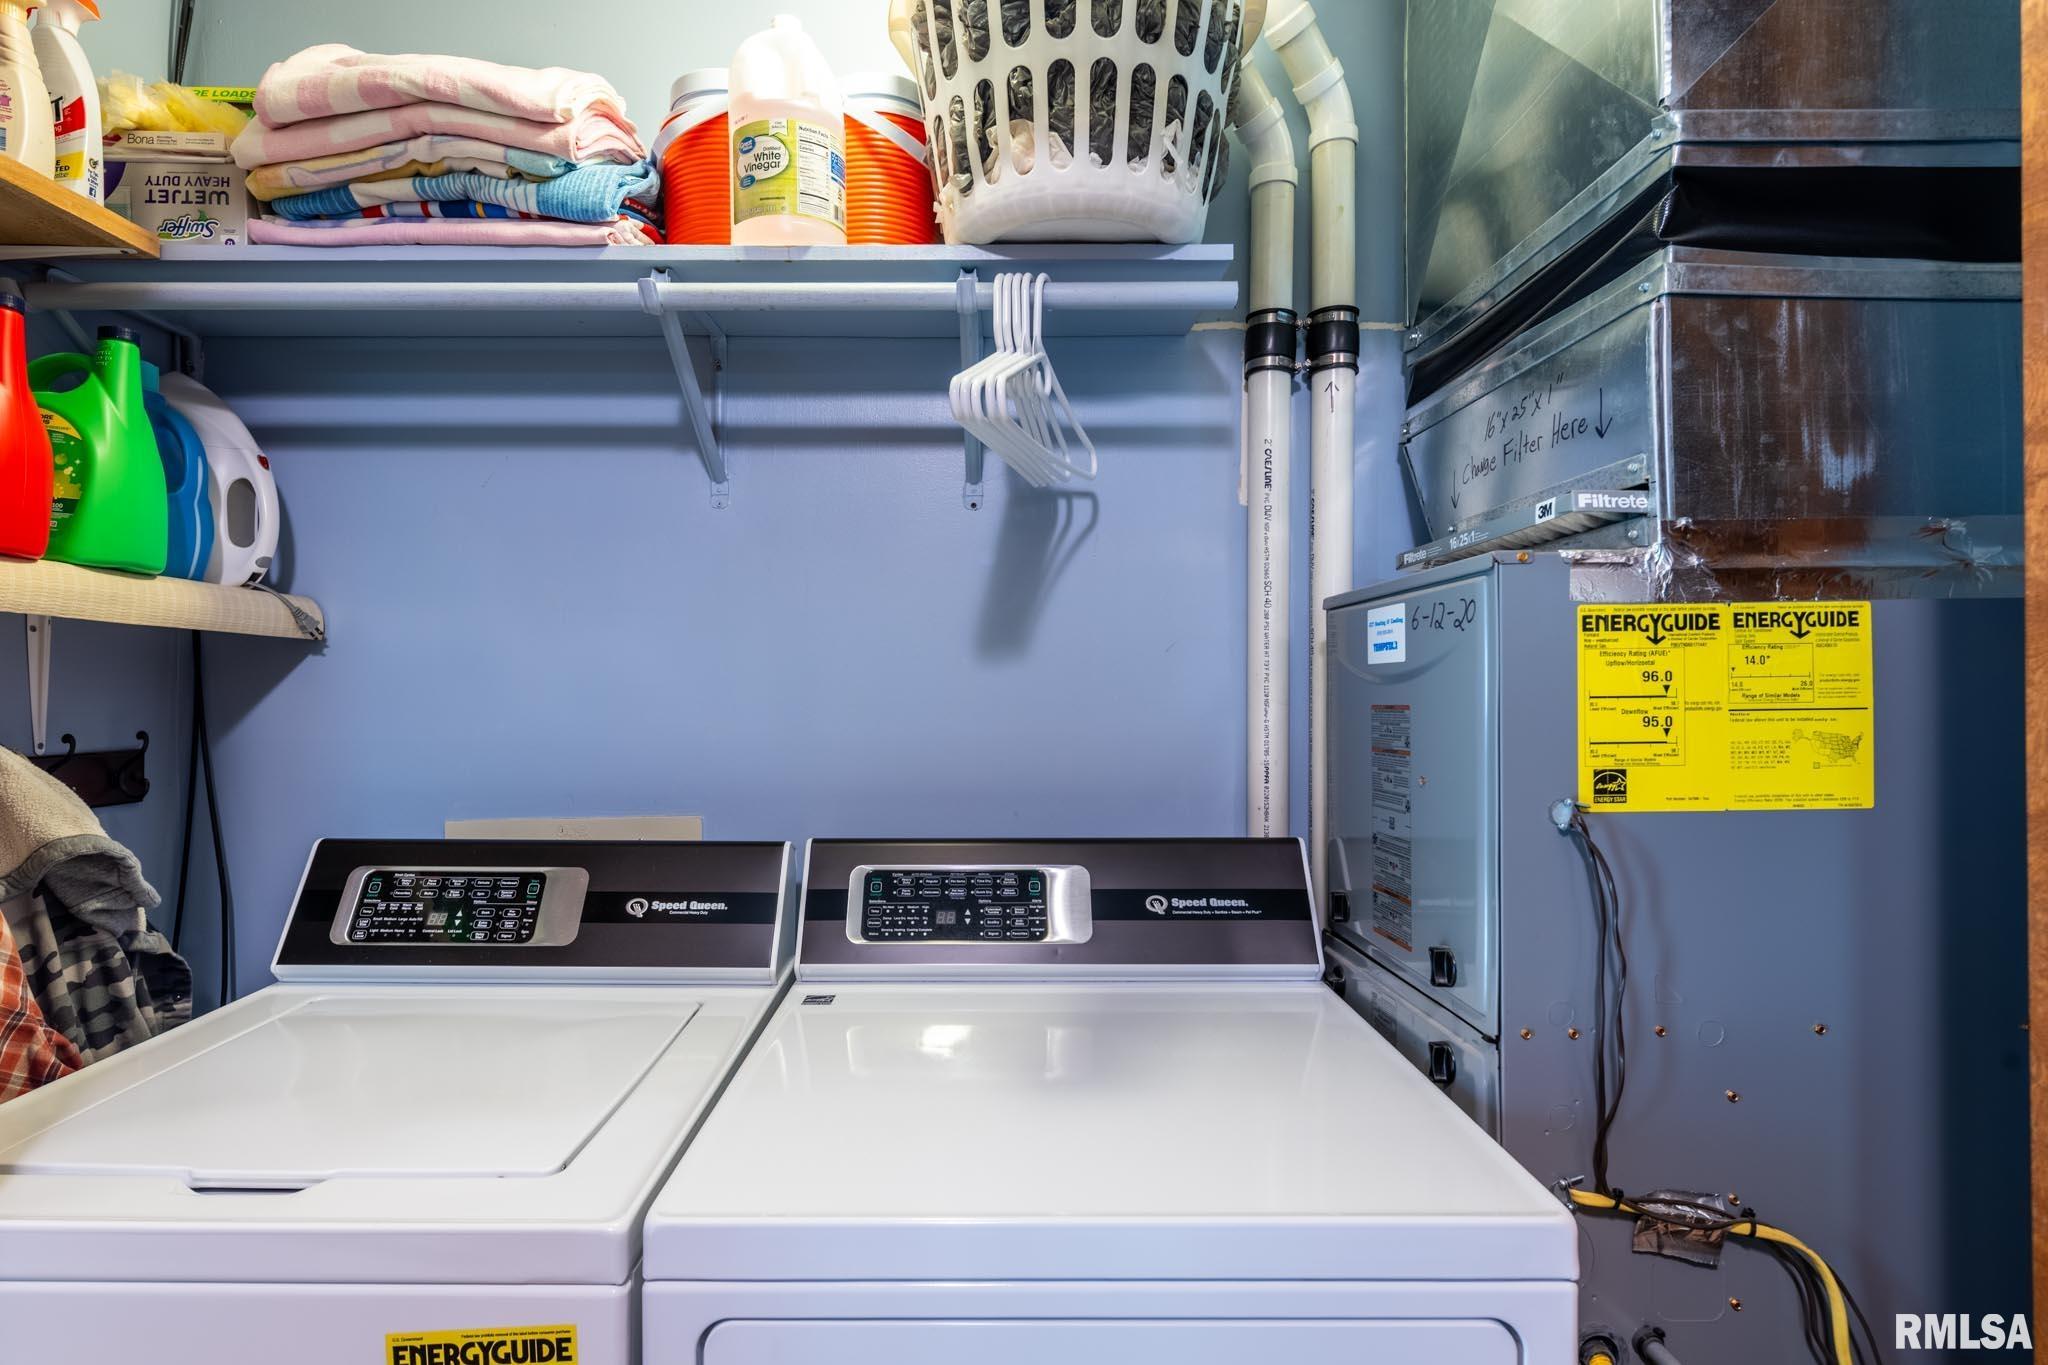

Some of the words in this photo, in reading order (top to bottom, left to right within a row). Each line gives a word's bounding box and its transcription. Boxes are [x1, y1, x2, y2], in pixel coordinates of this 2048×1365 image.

[212, 90, 256, 98] LOADS
[127, 134, 155, 145] Bona
[754, 150, 782, 162] White
[744, 160, 780, 174] Vinegar
[144, 175, 181, 187] DUTY
[184, 176, 230, 188] HEAVY
[144, 189, 230, 206] WETJET
[158, 214, 220, 238] Swiffer
[1463, 455, 1497, 485] Change
[1503, 430, 1543, 467] Filter
[1552, 411, 1588, 448] Here
[1578, 493, 1648, 508] Filtrete
[1538, 502, 1553, 520] 3M
[1403, 549, 1428, 565] Filtrete
[1264, 580, 1272, 596] SCH
[1264, 597, 1272, 608] 40
[1410, 598, 1476, 632] 6-12-20
[1733, 610, 1860, 631] ENERGYGUIDE
[1582, 613, 1720, 635] ENERGYGUIDE
[1642, 670, 1673, 682] 96.0
[1642, 716, 1673, 728] 95.0
[651, 900, 688, 912] Speed
[1171, 898, 1207, 908] Speed
[392, 1337, 572, 1365] ENERGYGUIDE
